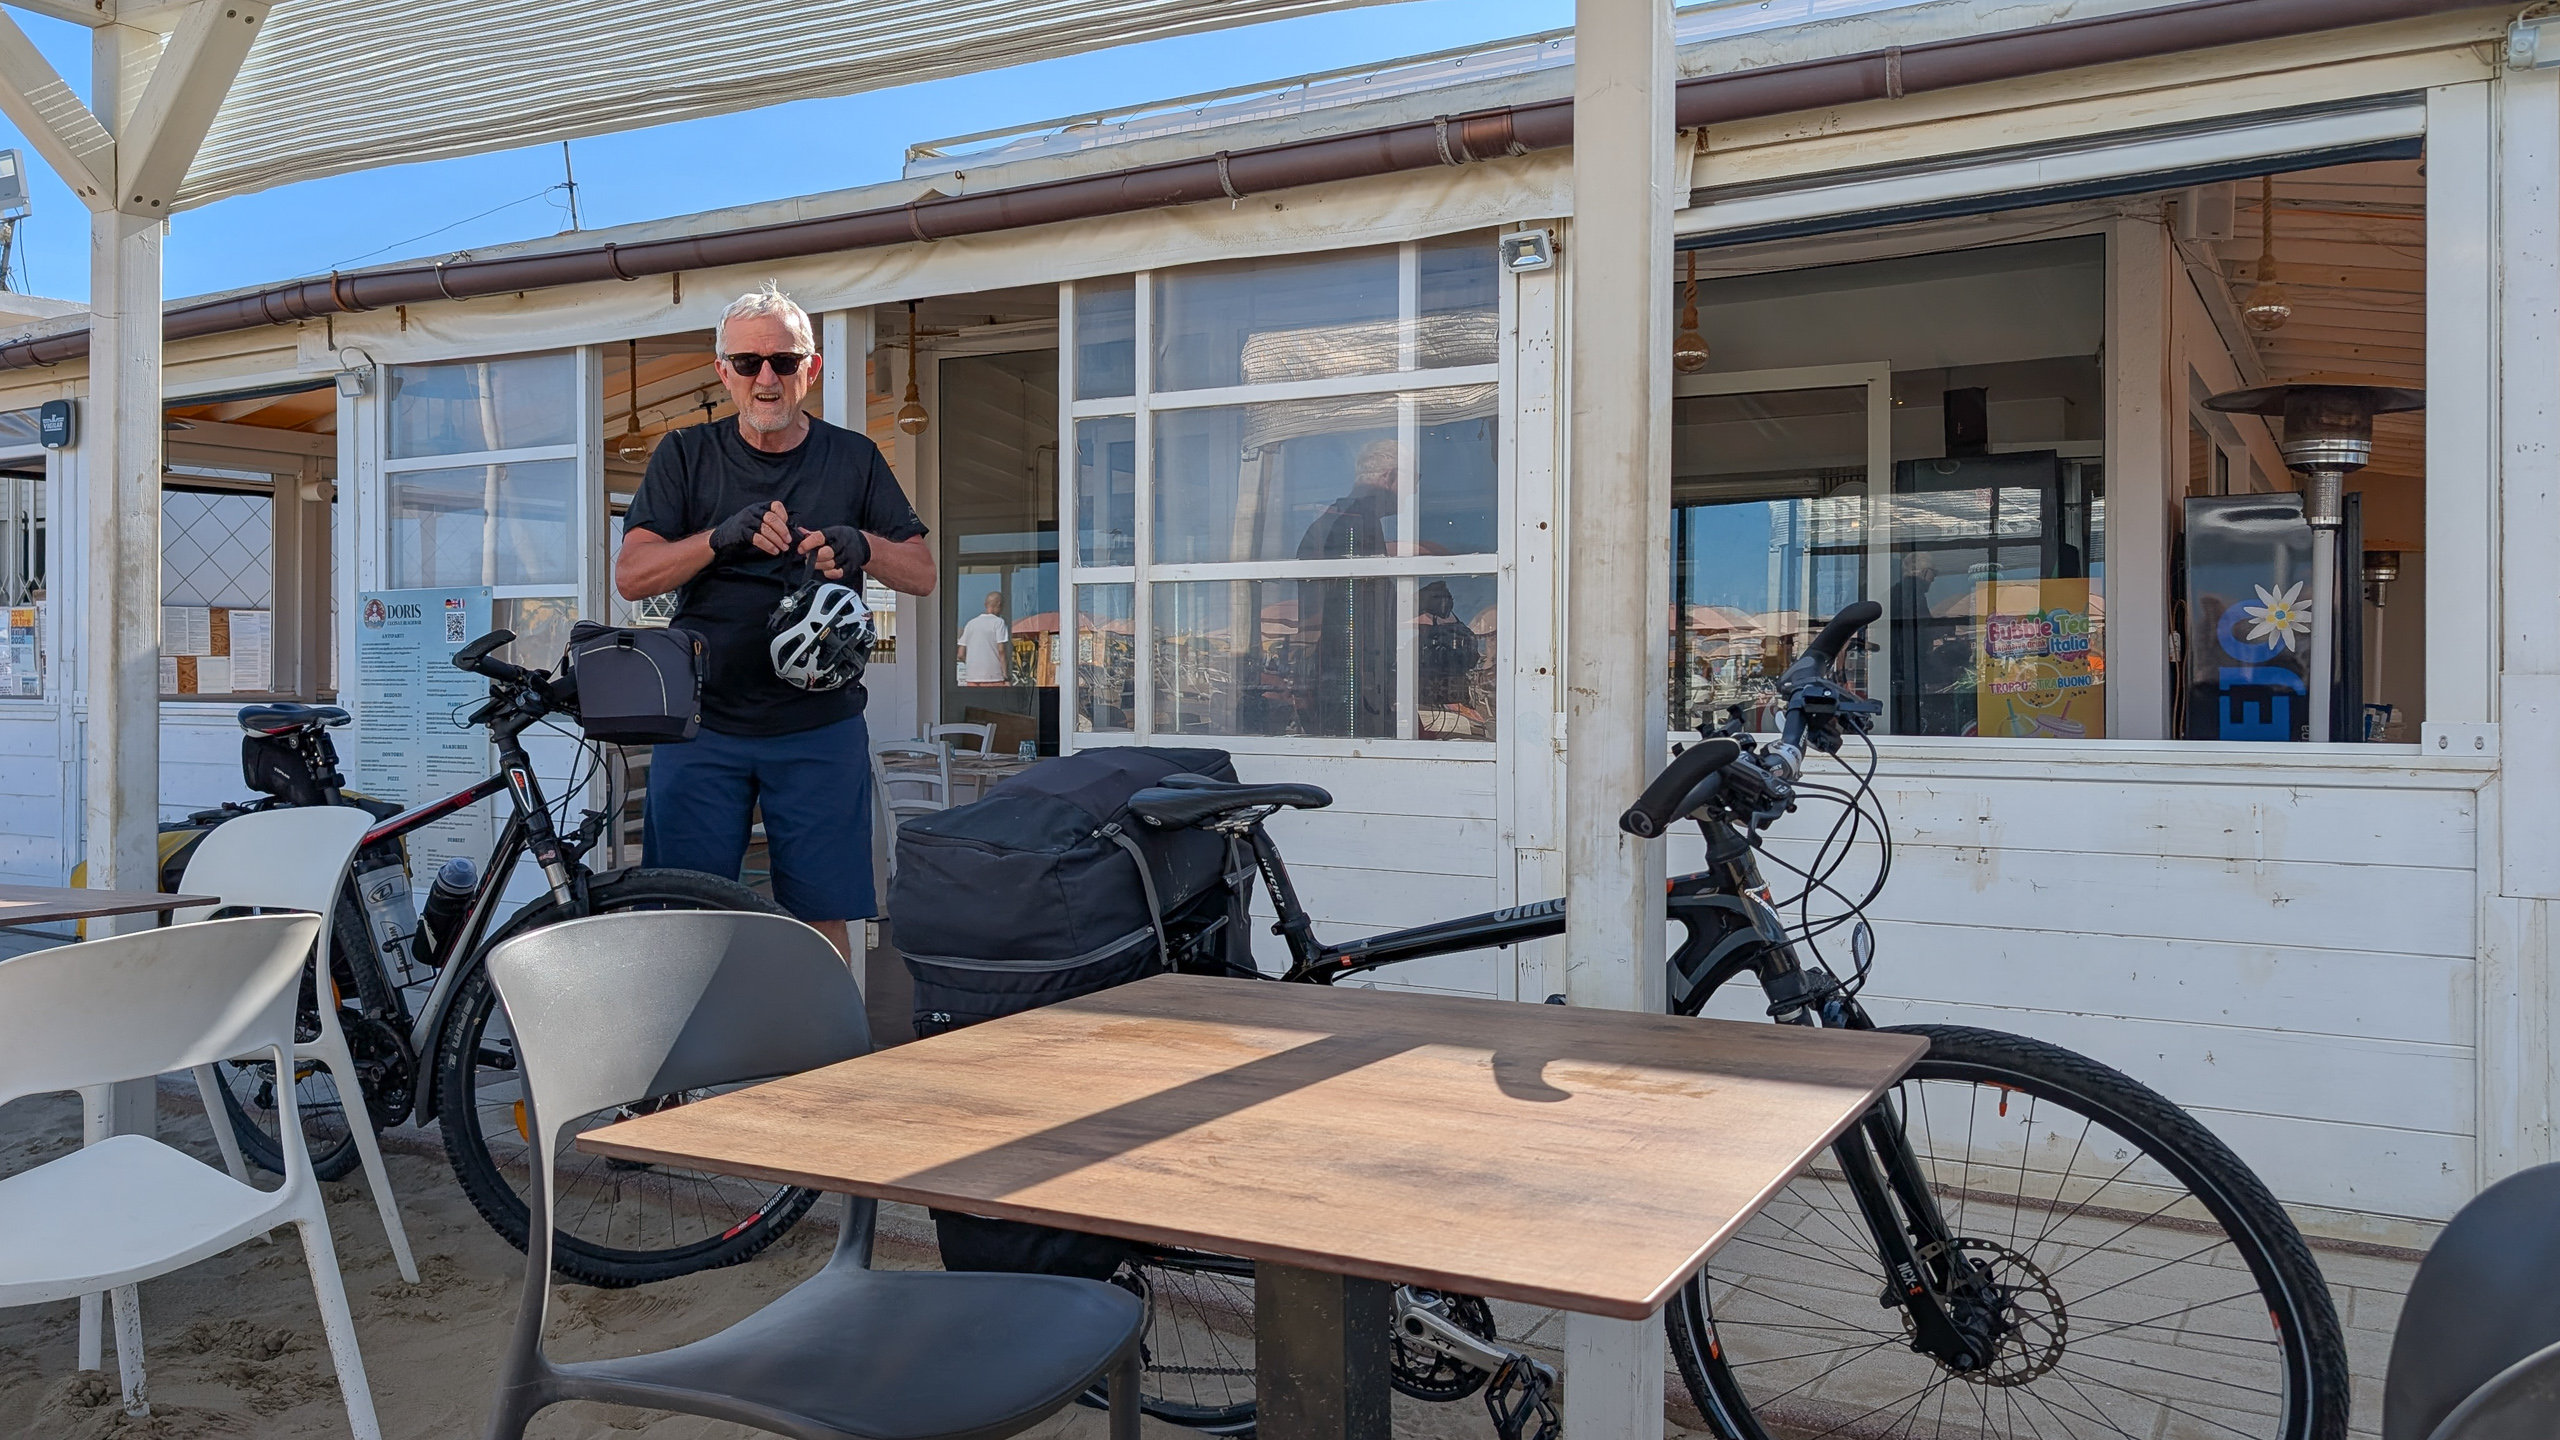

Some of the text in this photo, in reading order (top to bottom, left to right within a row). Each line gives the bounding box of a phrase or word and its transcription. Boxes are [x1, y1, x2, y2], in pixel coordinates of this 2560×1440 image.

[387, 604, 421, 619] DORIS
[1989, 615, 2090, 641] Bubble Tea
[2050, 636, 2089, 653] Italia
[1989, 675, 2092, 695] TROPPO STRABUONO
[1897, 1261, 1923, 1296] NCX-E
[1428, 1334, 1457, 1350] XT
